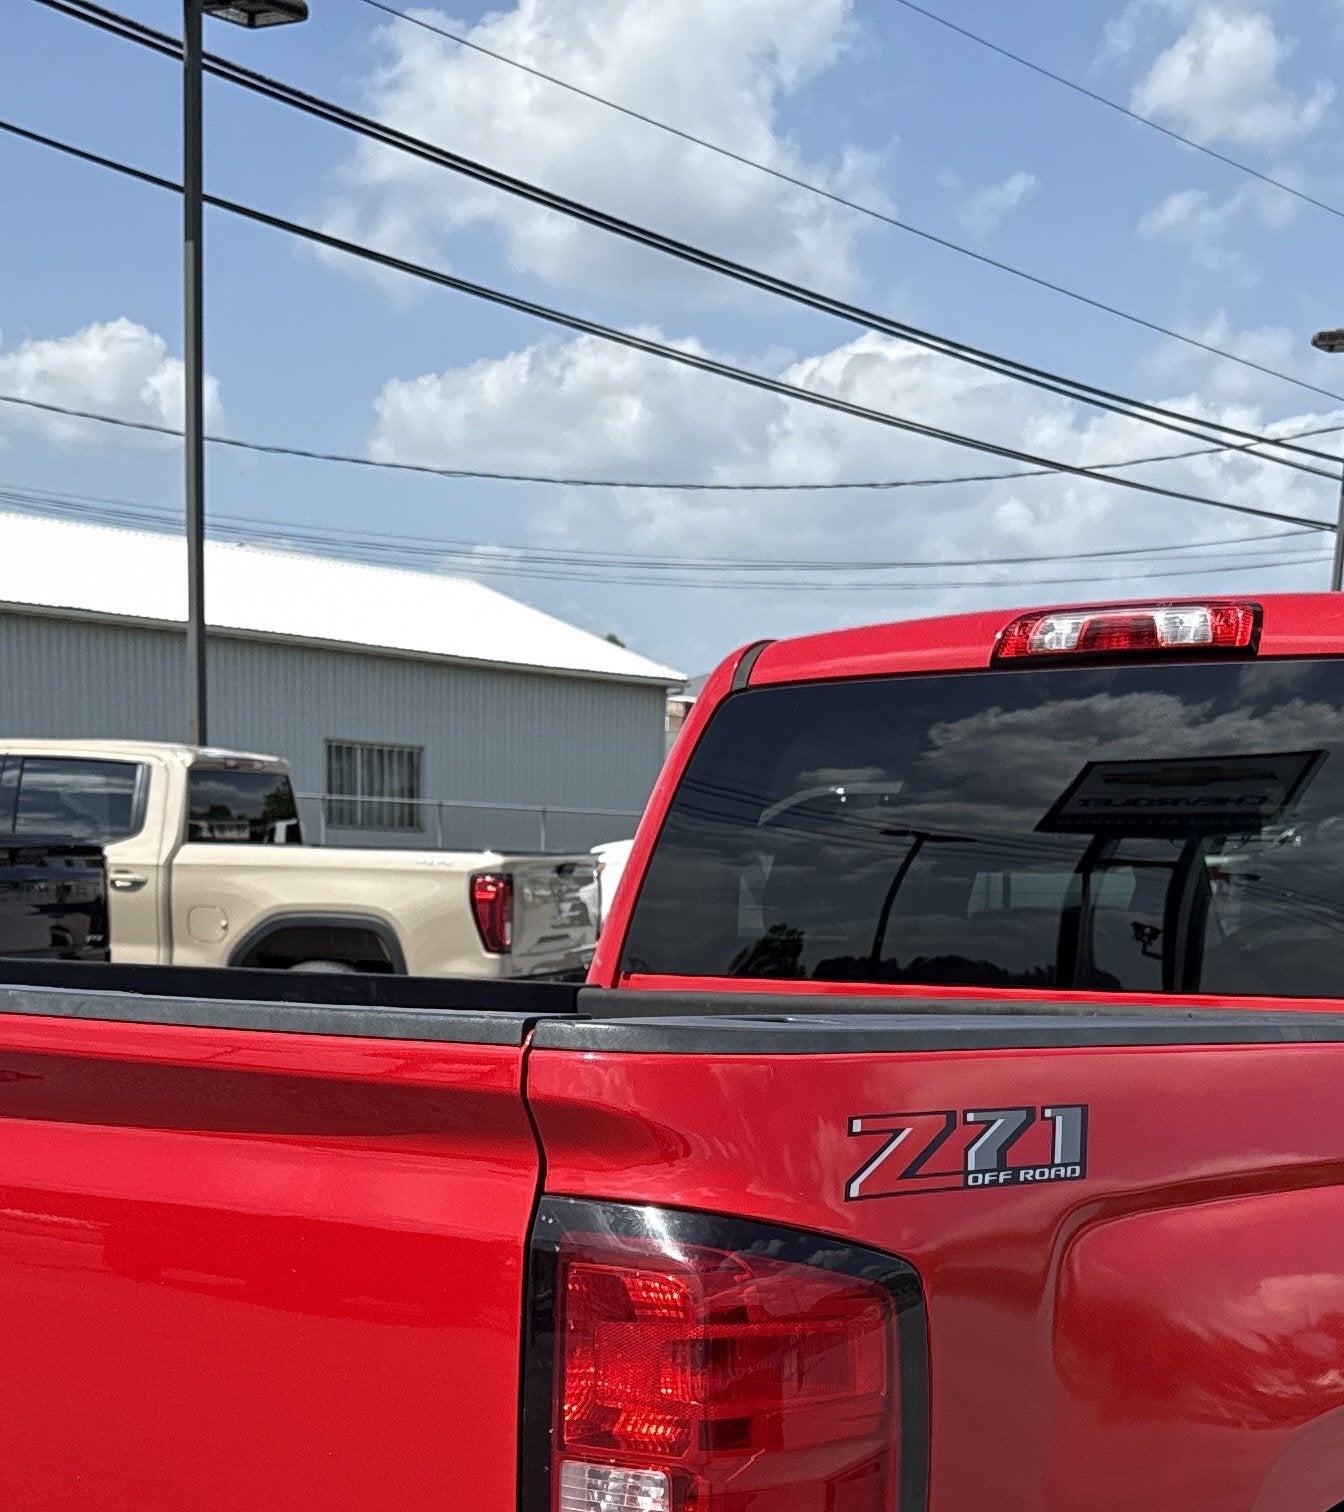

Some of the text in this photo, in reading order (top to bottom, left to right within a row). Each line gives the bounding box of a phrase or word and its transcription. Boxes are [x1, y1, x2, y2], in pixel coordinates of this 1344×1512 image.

[844, 1103, 1089, 1203] Z71
[967, 1165, 1081, 1186] OFF ROAD
